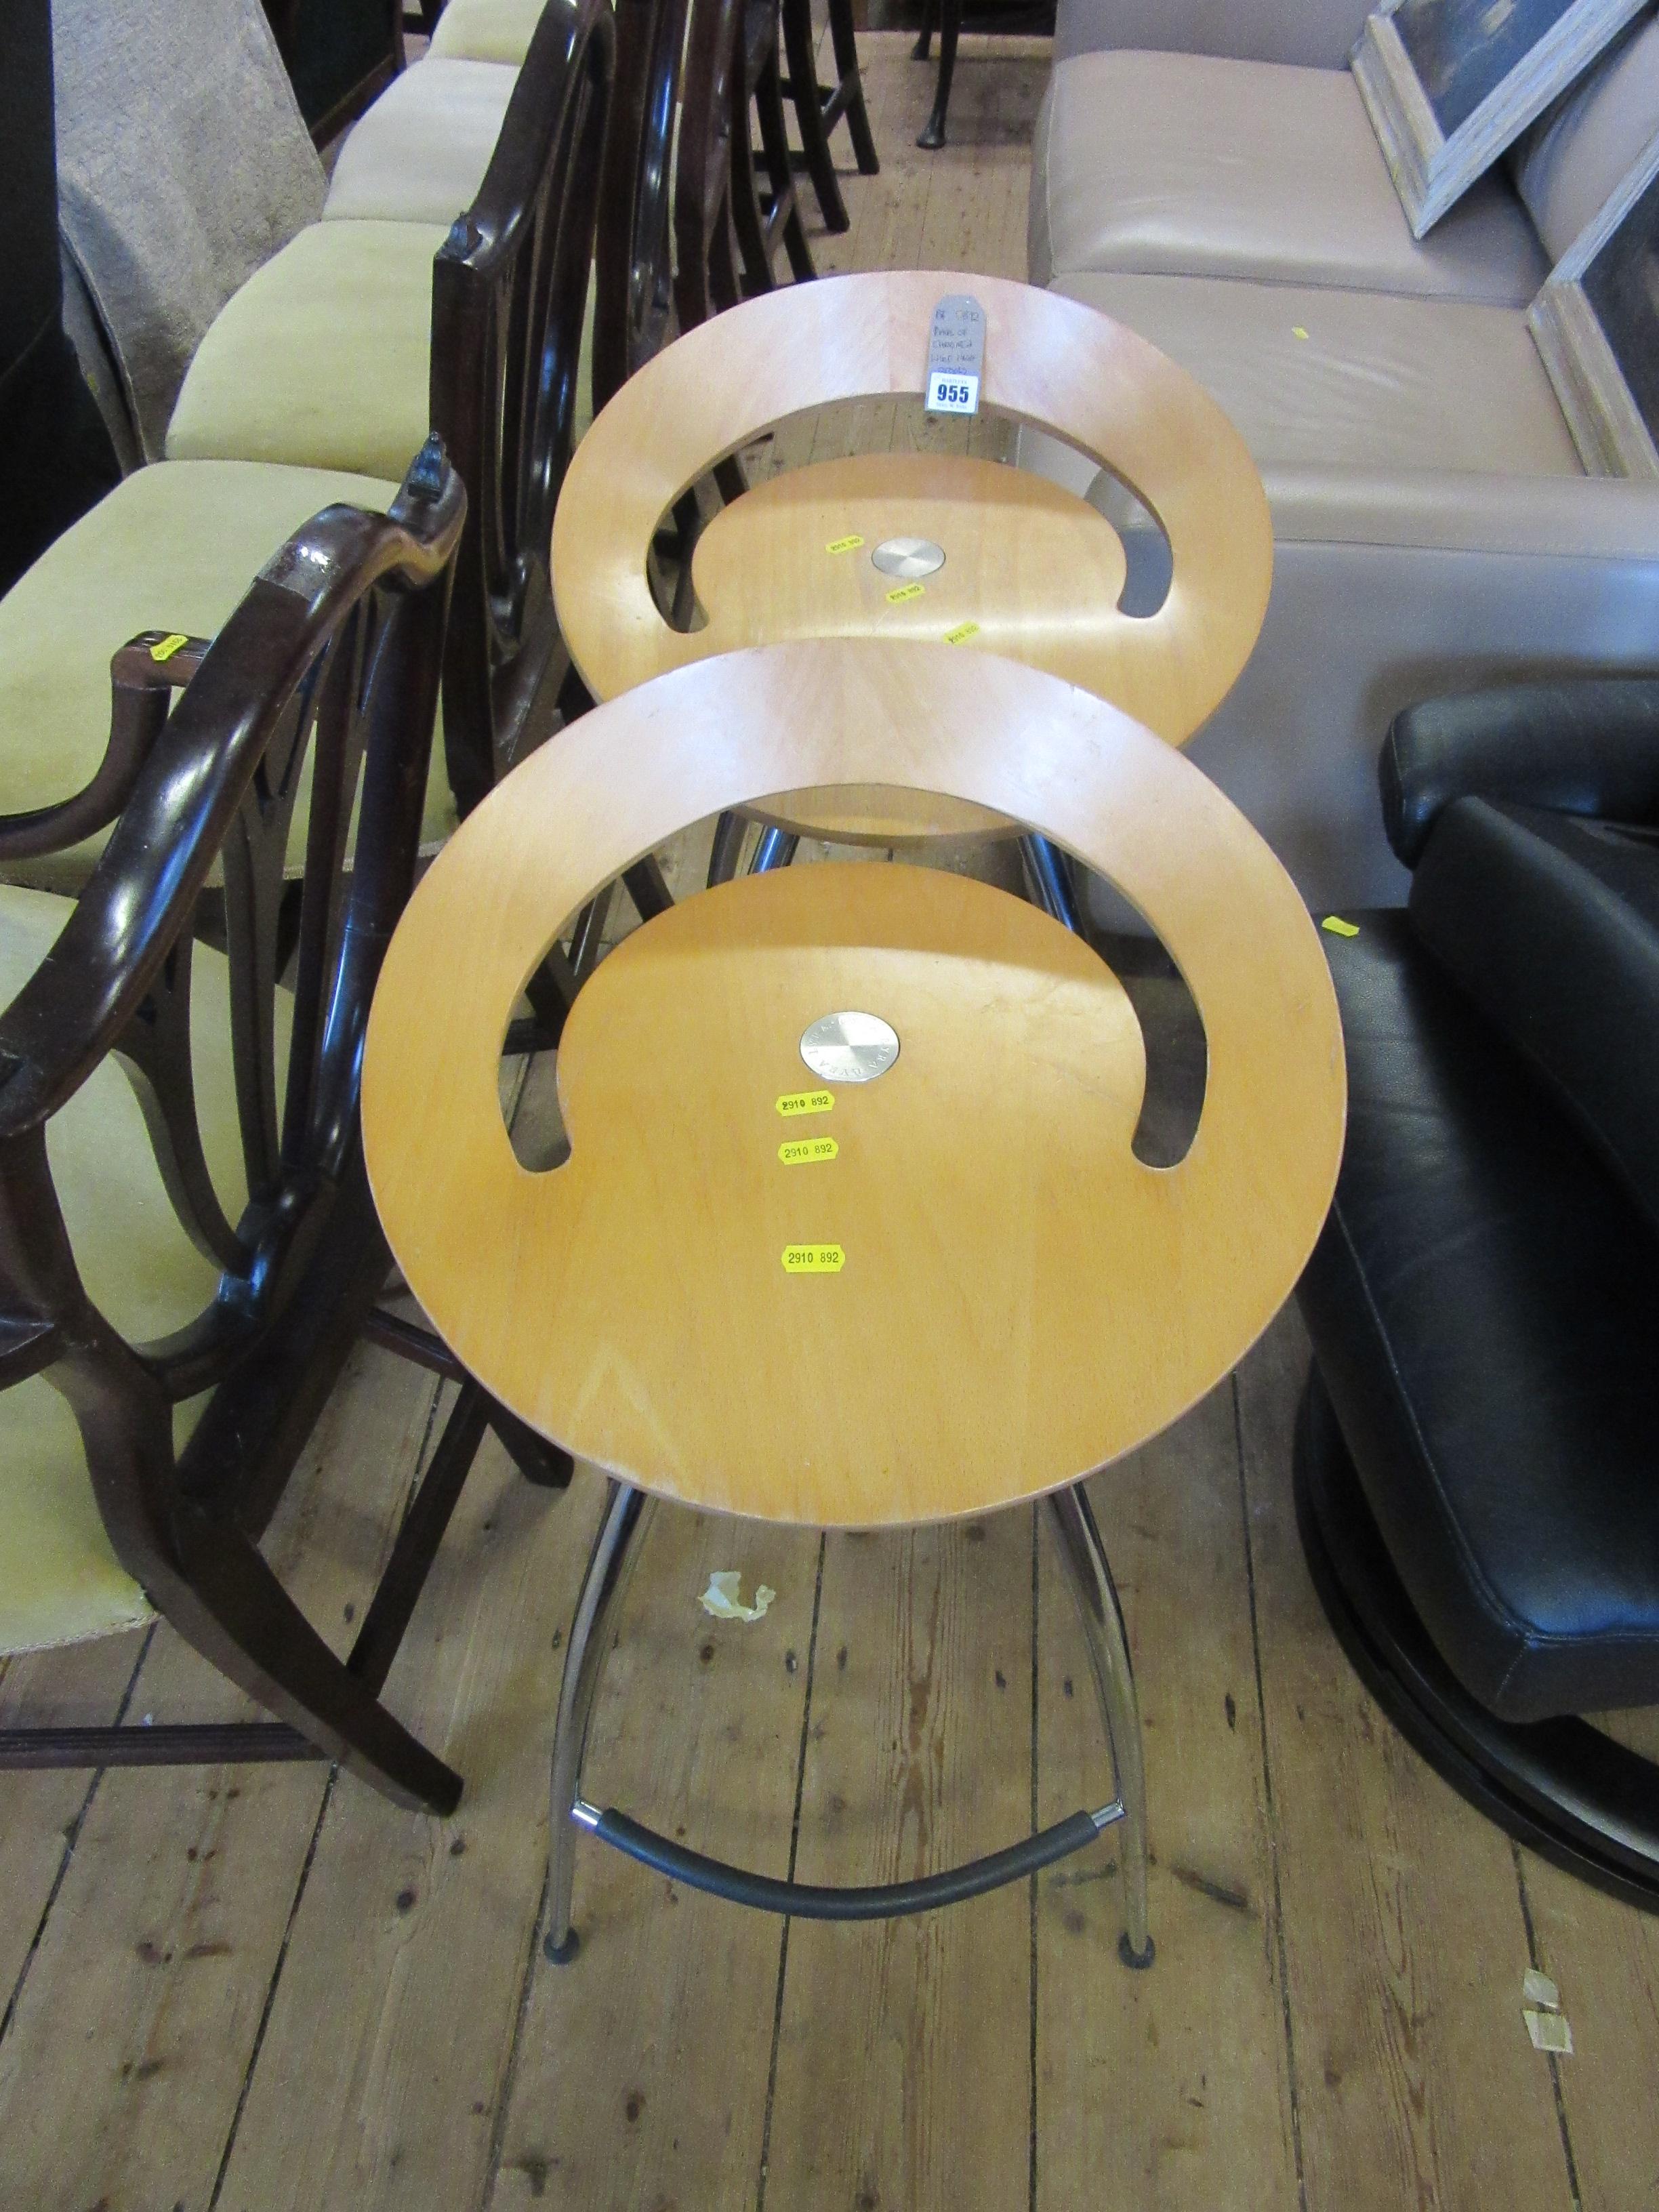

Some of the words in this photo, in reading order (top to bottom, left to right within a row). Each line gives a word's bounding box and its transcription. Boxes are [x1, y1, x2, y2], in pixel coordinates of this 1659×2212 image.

[937, 384, 969, 403] 955
[782, 1099, 806, 1110] 2910
[811, 1096, 830, 1106] 892
[784, 1146, 808, 1158] 2910
[815, 1143, 833, 1154] 892
[788, 1252, 813, 1264] 2910
[820, 1251, 839, 1263] 892
